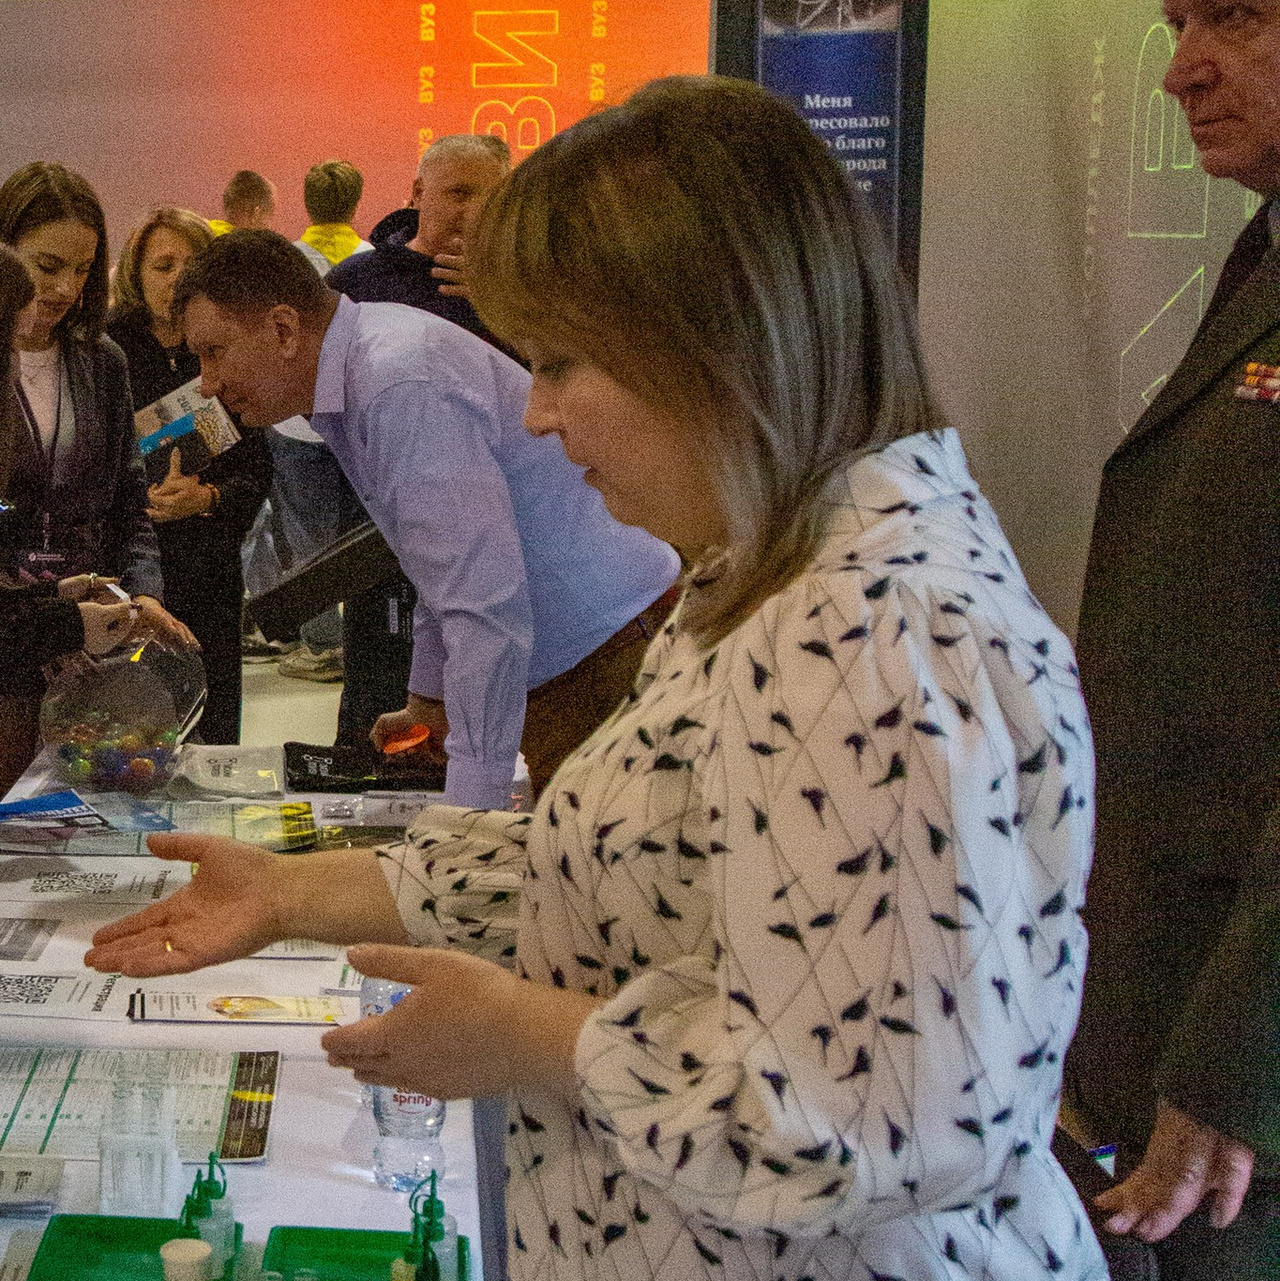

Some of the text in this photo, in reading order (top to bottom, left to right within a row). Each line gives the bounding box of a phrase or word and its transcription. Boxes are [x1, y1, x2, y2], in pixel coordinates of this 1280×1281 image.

[420, 2, 436, 41] ВУЗ
[592, 0, 609, 38] ВУЗ
[419, 65, 435, 104] ВУЗ
[589, 62, 606, 102] ВУЗ
[804, 94, 853, 109] Меня
[808, 116, 890, 130] ресовало
[419, 127, 434, 153] УЗ
[835, 133, 886, 151] благо
[844, 158, 887, 172] рода
[392, 1093, 432, 1108] spring
